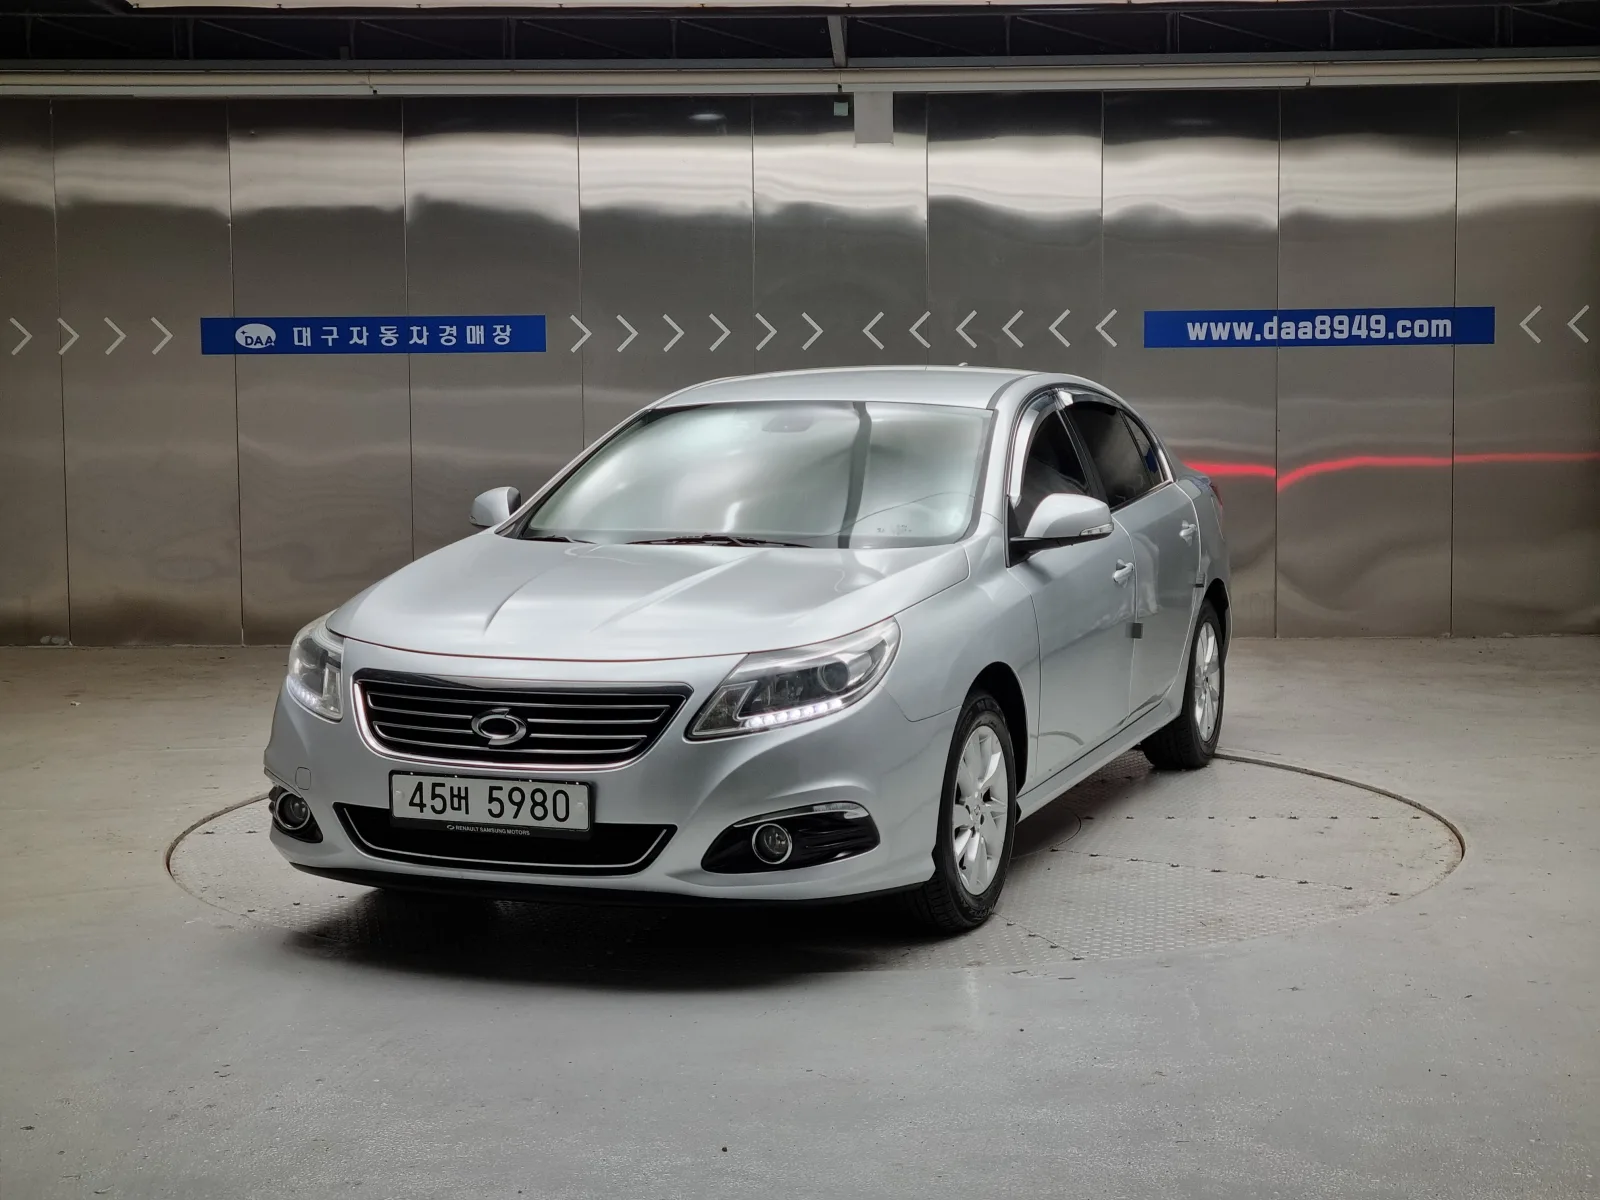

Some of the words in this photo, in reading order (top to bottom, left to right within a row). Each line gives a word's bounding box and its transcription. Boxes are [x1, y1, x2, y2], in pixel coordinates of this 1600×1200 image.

[292, 324, 512, 347] 대구자동차경매장
[1187, 315, 1452, 340] www.daa8949.com
[245, 335, 275, 346] DAA
[408, 781, 470, 815] 45버
[487, 785, 570, 823] 5980
[480, 826, 506, 834] SAMSUNG
[506, 828, 531, 836] MOTORS
